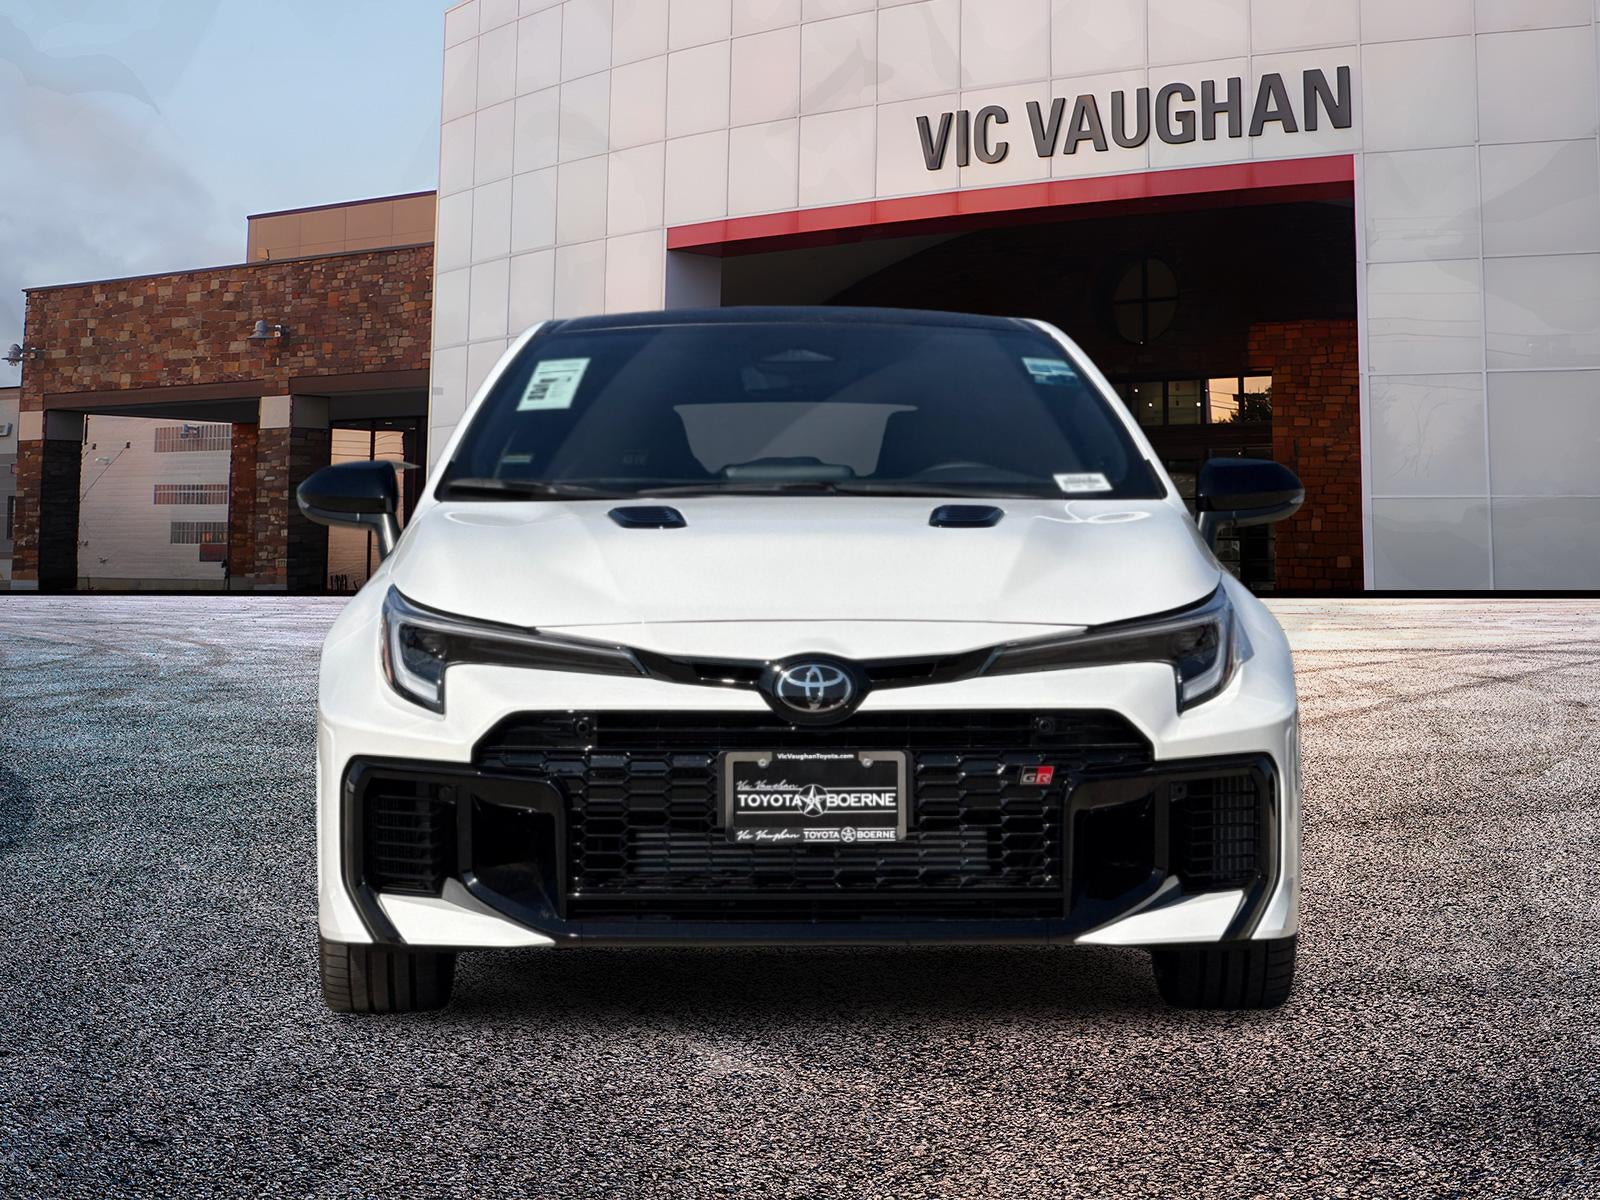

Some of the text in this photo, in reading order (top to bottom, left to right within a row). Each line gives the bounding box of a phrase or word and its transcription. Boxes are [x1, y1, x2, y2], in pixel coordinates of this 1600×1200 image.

[916, 66, 1352, 170] VIC VAUGHAN
[737, 794, 802, 807] TOYOTA
[826, 793, 896, 807] BOERNE
[803, 831, 840, 839] TOYOTA
[857, 830, 895, 839] BOERNE
